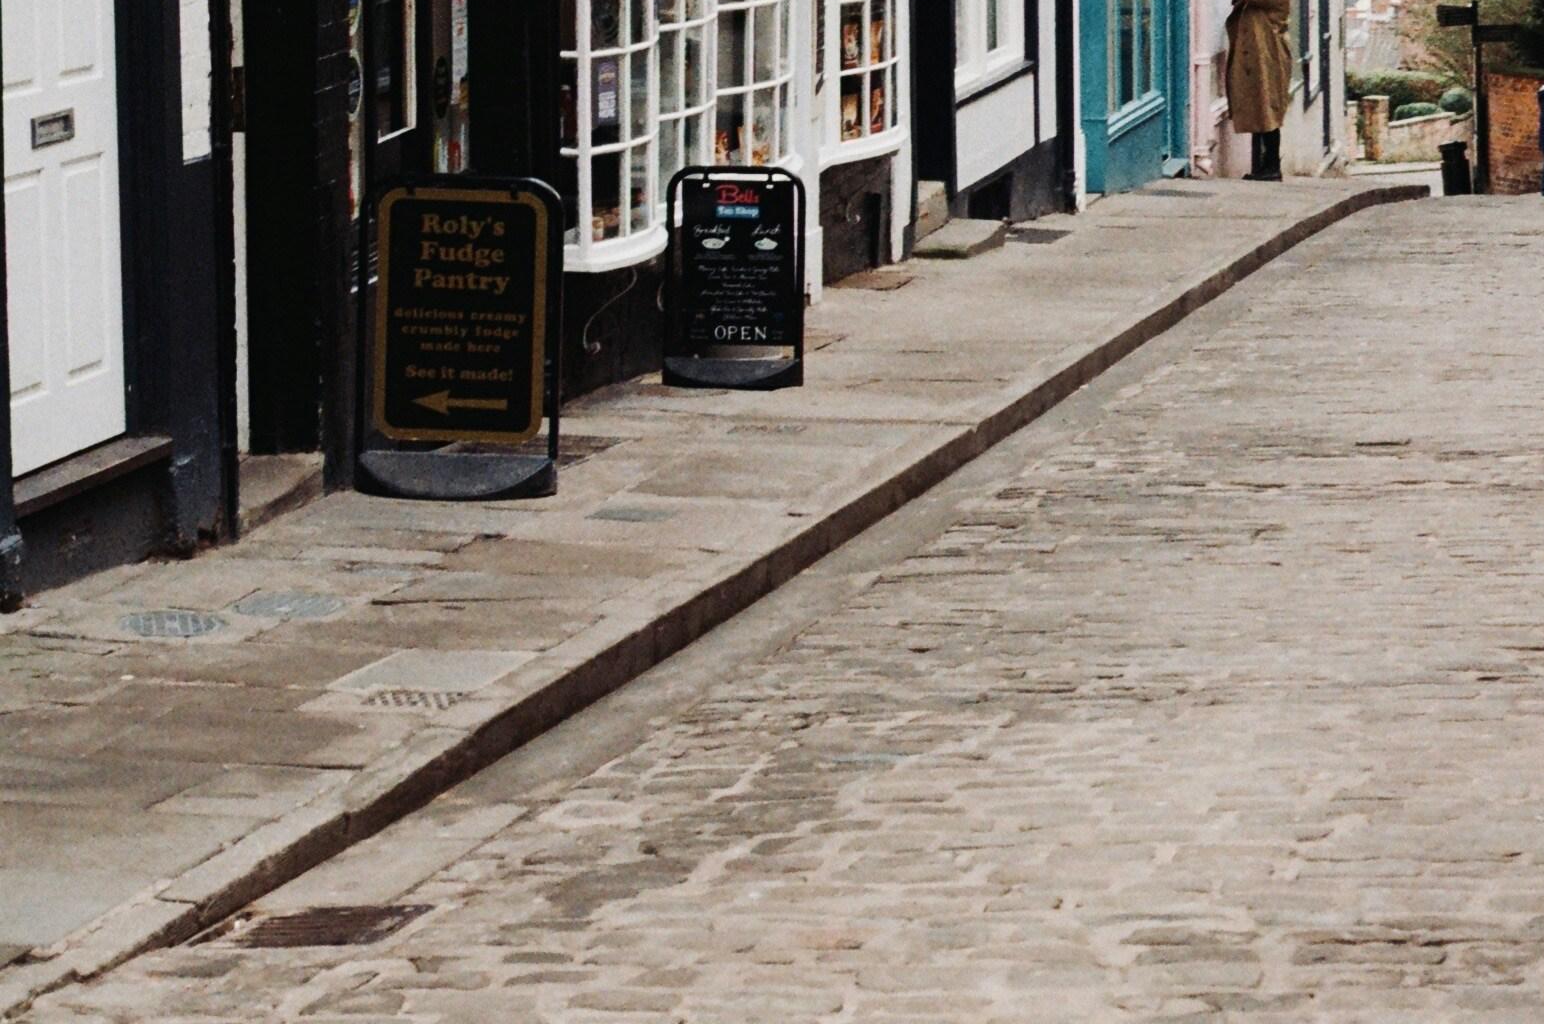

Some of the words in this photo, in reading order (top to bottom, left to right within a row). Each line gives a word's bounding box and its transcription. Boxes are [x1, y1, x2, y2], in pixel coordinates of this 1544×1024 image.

[421, 214, 505, 238] Roly's
[420, 241, 505, 268] Fudge
[414, 267, 510, 295] Pantry
[714, 325, 767, 340] OPEN
